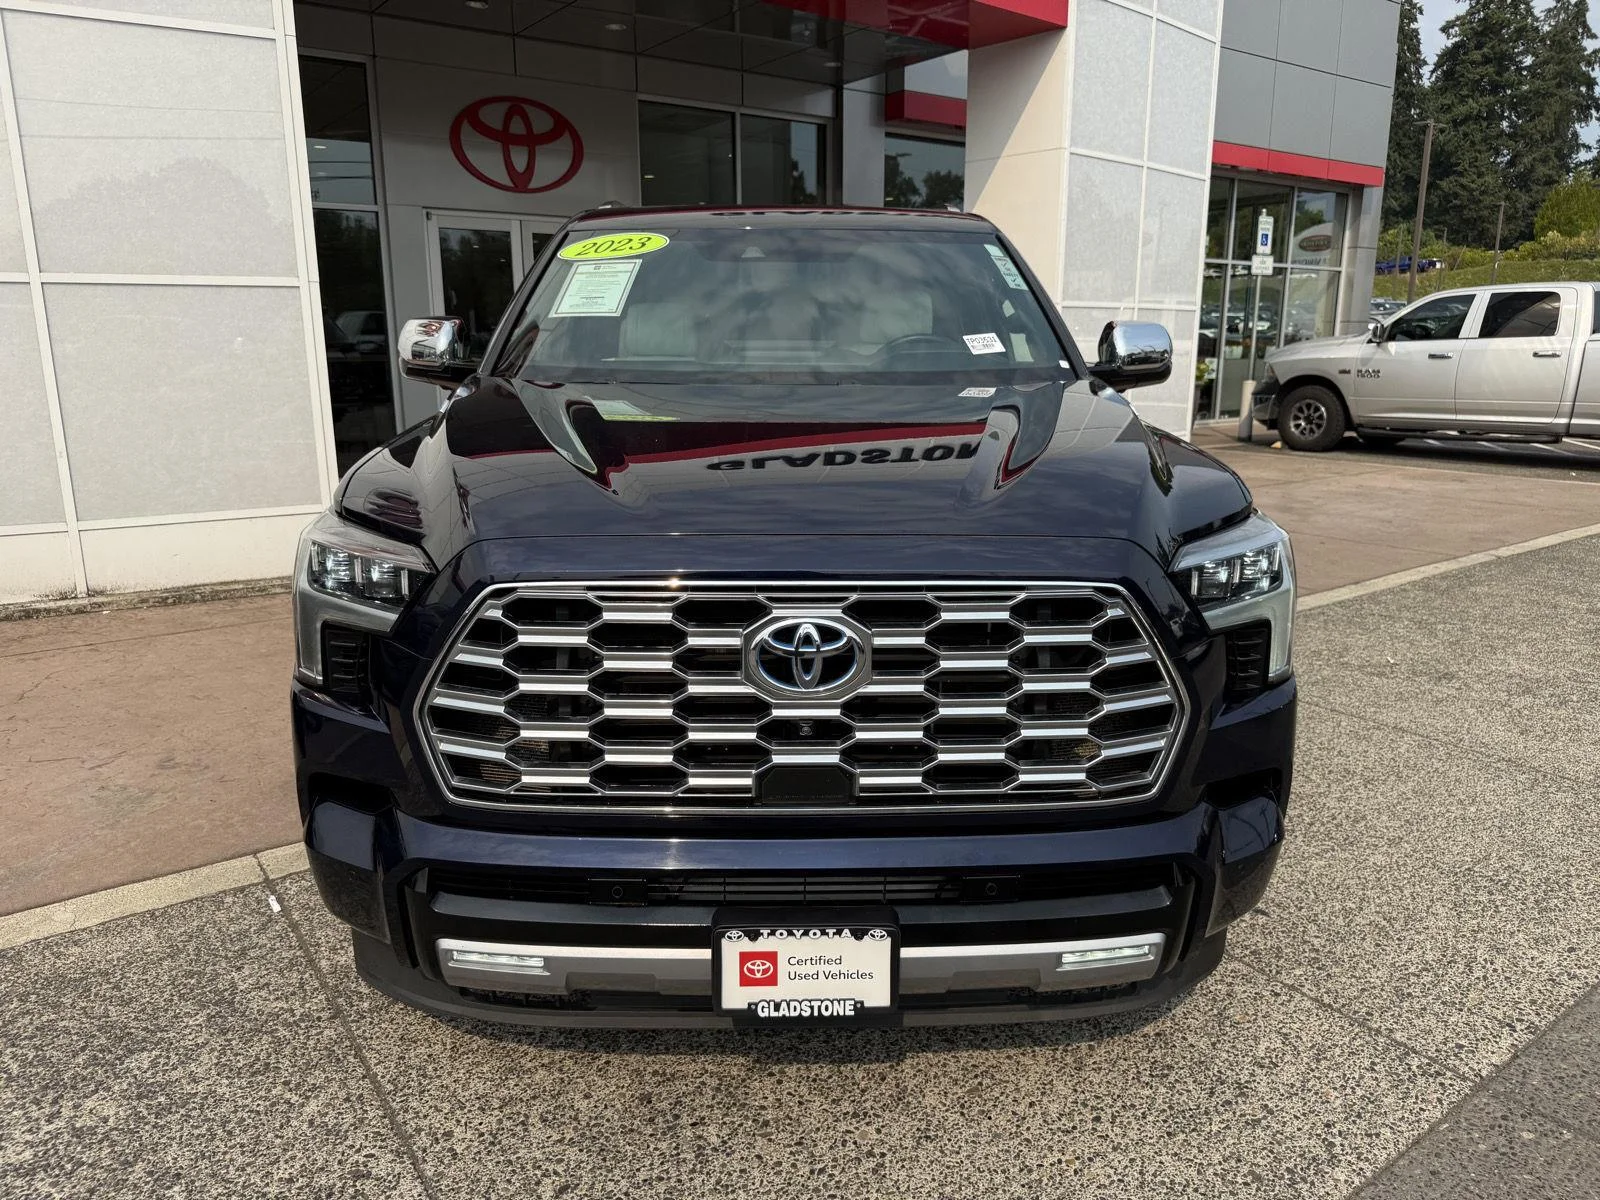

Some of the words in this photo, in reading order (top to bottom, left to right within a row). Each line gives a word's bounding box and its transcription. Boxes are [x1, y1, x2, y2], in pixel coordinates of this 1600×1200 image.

[575, 237, 652, 256] 2023
[759, 929, 852, 940] TOYOTA
[787, 955, 842, 966] Certified
[787, 970, 819, 981] Used
[823, 970, 874, 981] Vehicles
[757, 1001, 855, 1017] GLADSTONE
